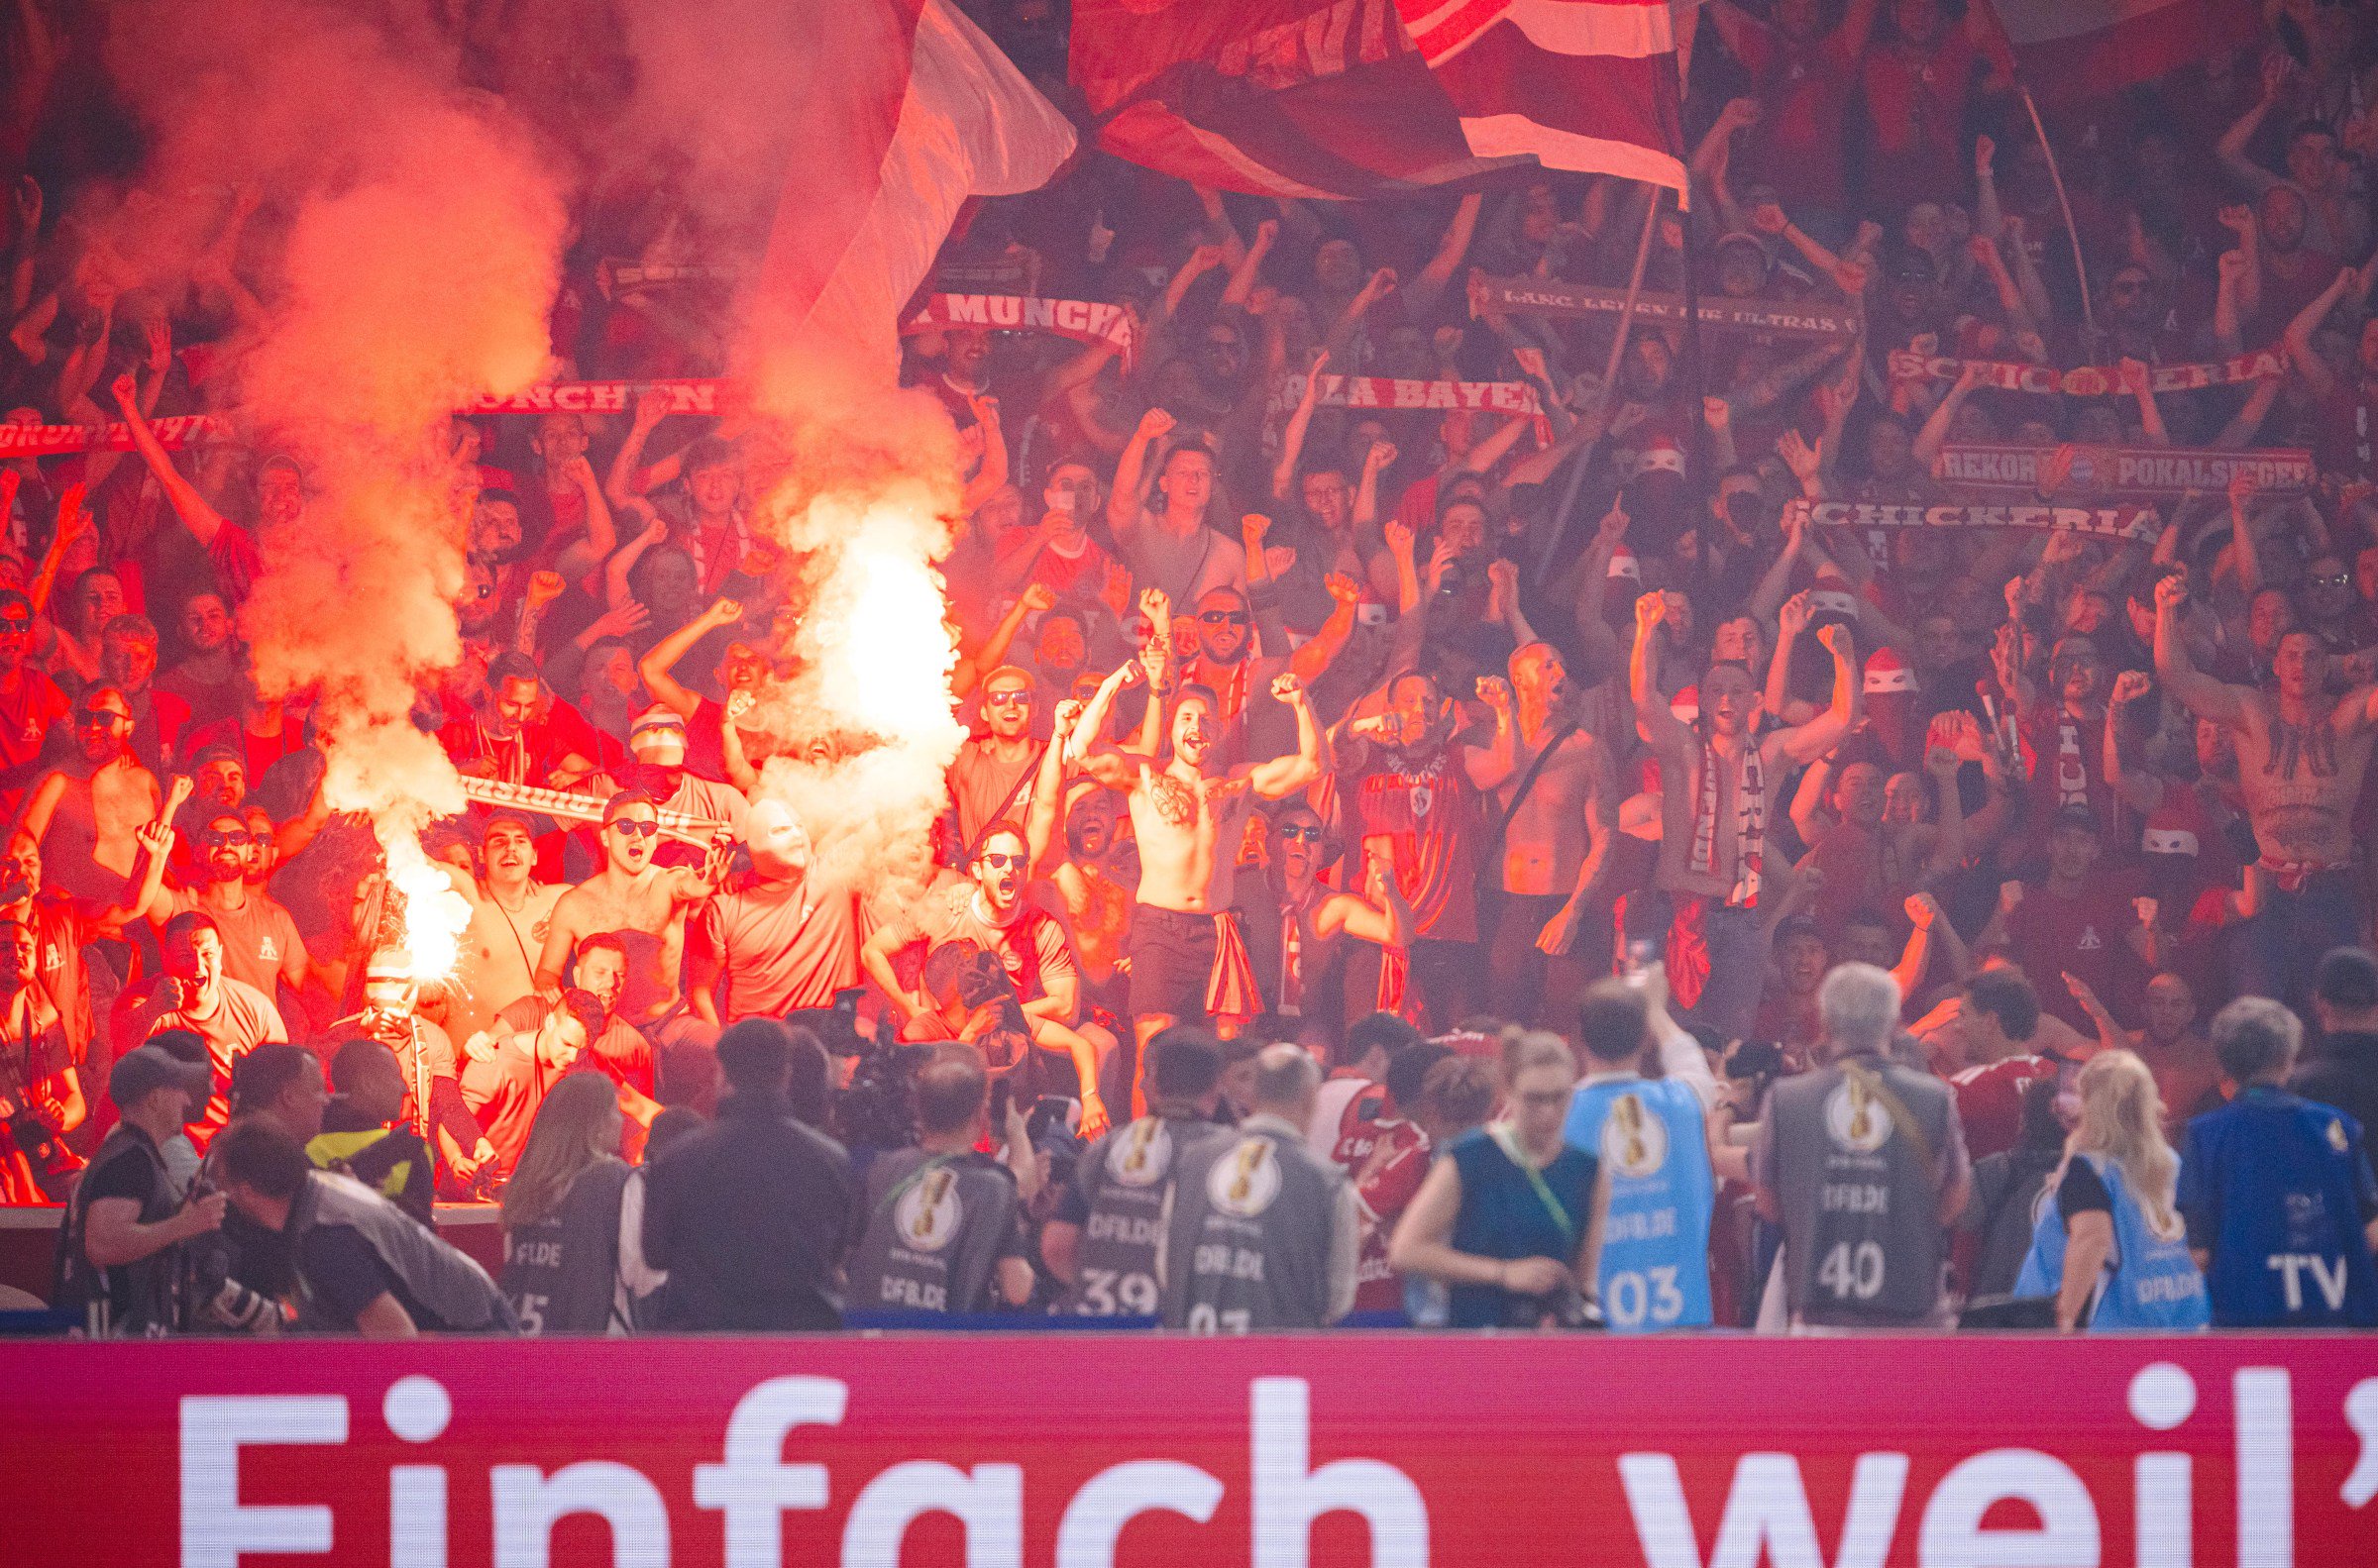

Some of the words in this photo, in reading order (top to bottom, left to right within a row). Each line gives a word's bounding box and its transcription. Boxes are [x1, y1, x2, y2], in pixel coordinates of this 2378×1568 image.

[1077, 1269, 1158, 1316] 39
[1607, 1264, 1683, 1325] 03
[1819, 1240, 1886, 1300] 40
[2266, 1254, 2348, 1310] TV
[179, 1374, 1430, 1568] Einfach
